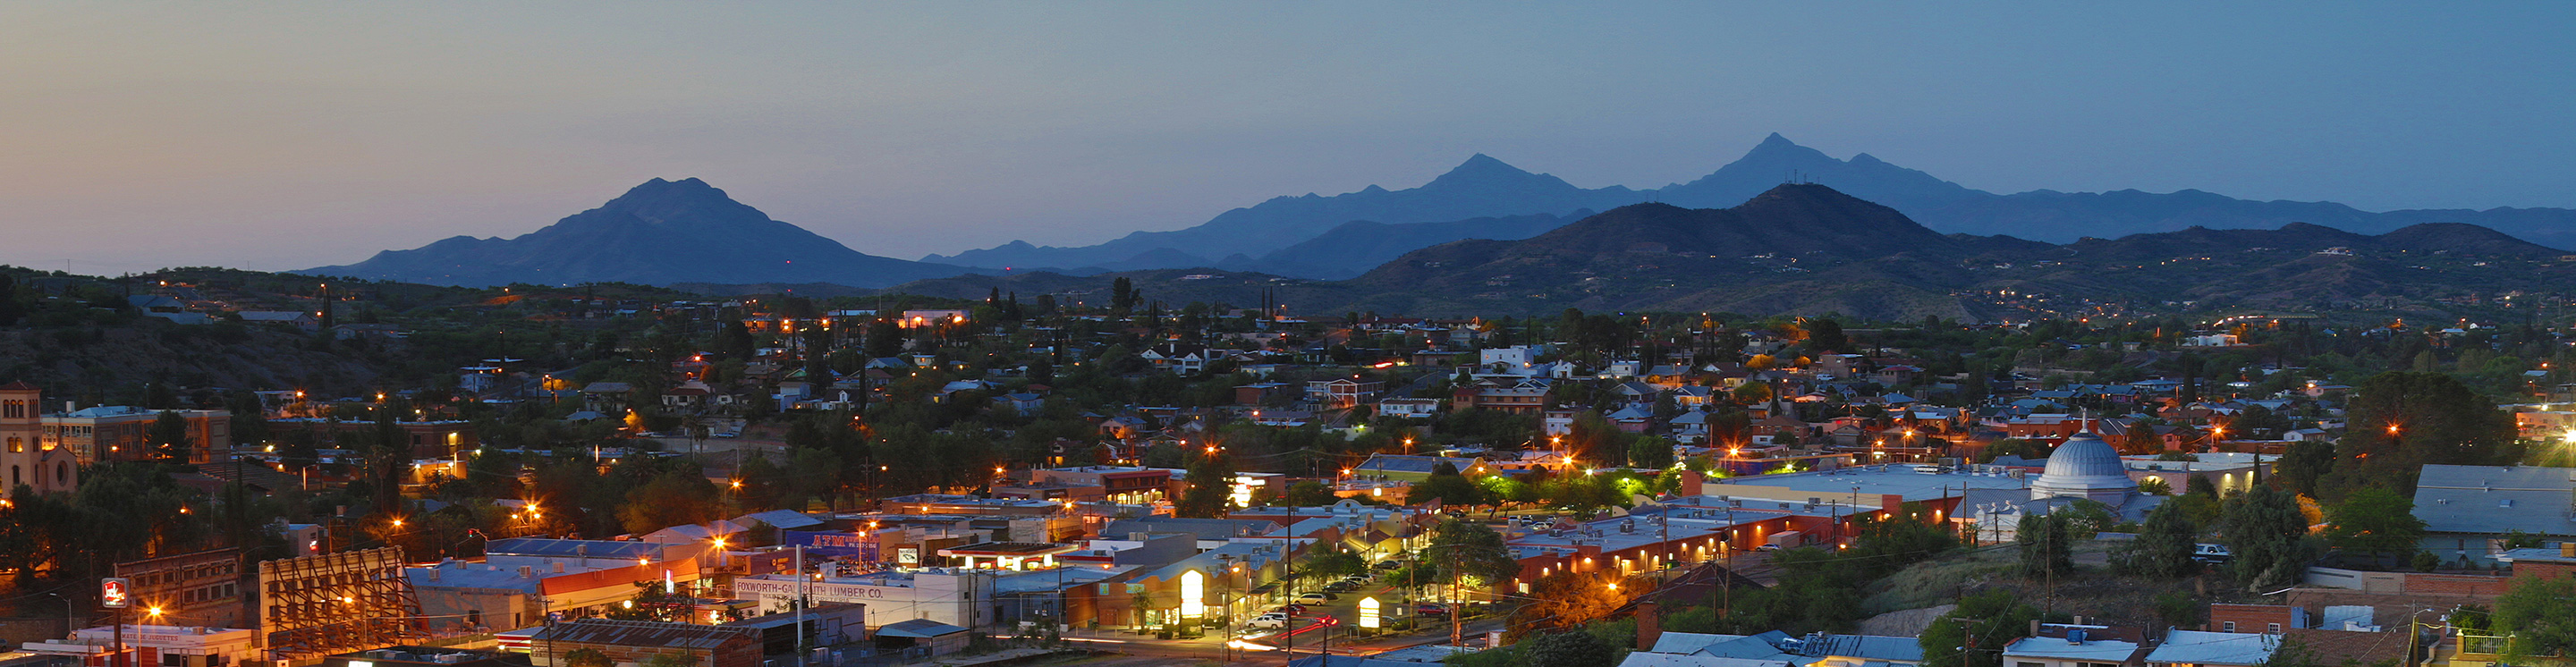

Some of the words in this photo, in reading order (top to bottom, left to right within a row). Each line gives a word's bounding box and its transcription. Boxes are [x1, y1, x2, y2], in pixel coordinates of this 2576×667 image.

[812, 535, 845, 546] ATM
[737, 582, 826, 596] FOXWORTH-GALRAITH
[830, 587, 865, 597] LUMBER
[869, 588, 883, 598] CO.
